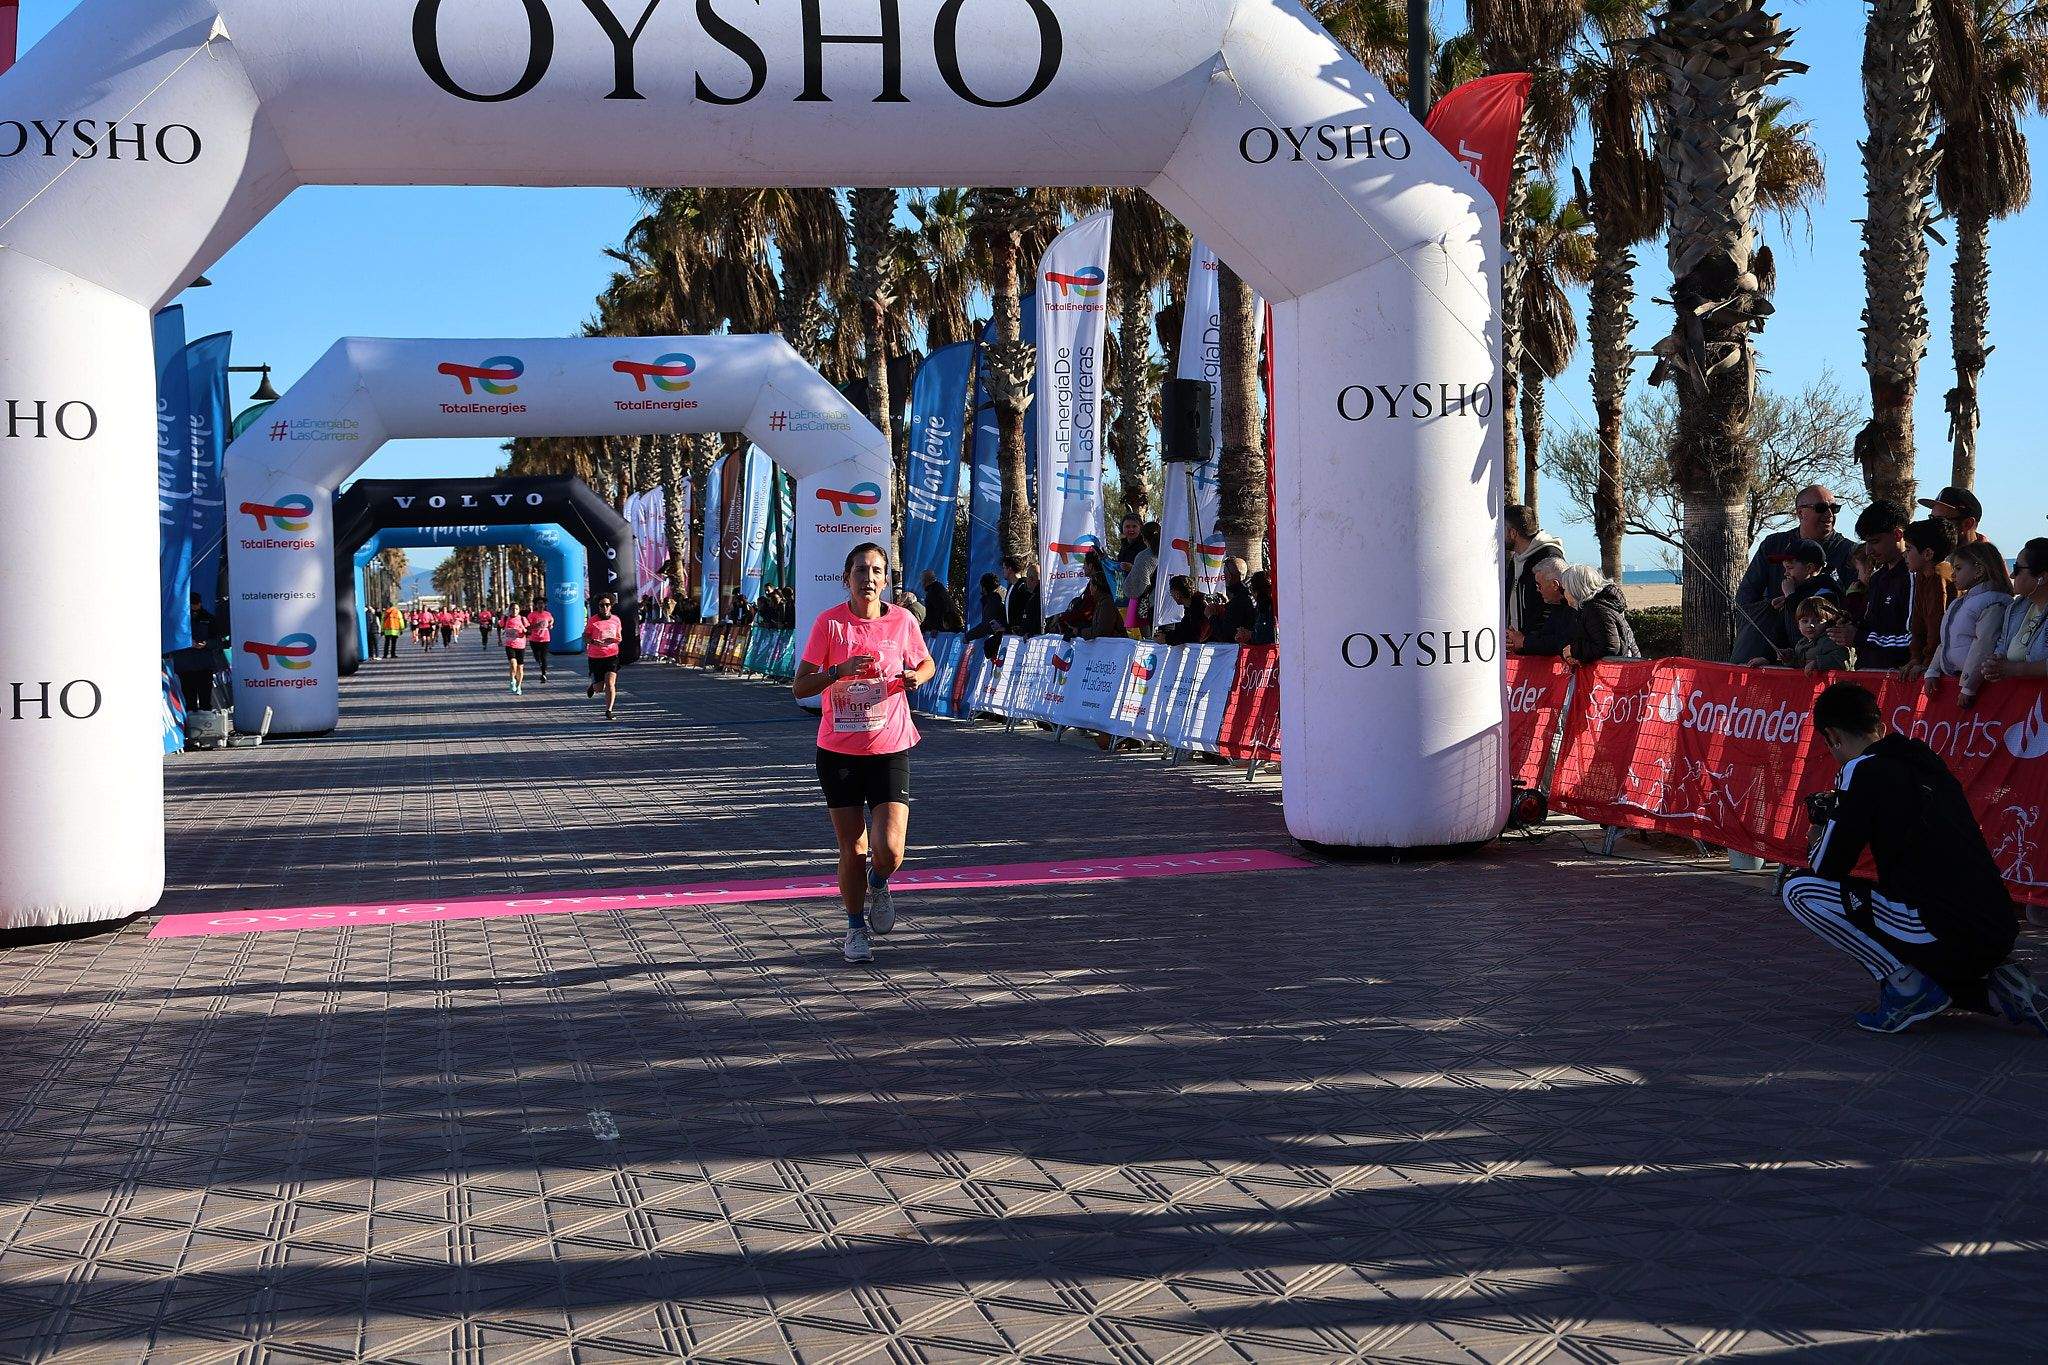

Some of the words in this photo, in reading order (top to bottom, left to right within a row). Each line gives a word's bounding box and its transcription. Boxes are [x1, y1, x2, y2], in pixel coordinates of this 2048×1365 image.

[412, 0, 1063, 107] OYSHO
[0, 119, 202, 165] OYSHO
[1239, 124, 1411, 164] OYSHO
[1046, 303, 1104, 313] TotalEnergies
[439, 403, 527, 415] TotalEnergies
[614, 398, 699, 412] TotalEnergies
[1055, 347, 1072, 464] LaEnergíaDe
[1075, 347, 1094, 463] LasCarreras
[1337, 382, 1493, 422] OYSHO
[5, 399, 98, 441] HO
[788, 421, 851, 431] LasCarreras
[290, 430, 359, 441] LasCarreras
[907, 415, 956, 523] Marlene
[394, 493, 543, 509] VOLVO
[815, 523, 882, 535] TotalEnergies
[240, 539, 315, 550] TotalEnergies
[242, 591, 316, 601] totalenergies.es
[1341, 627, 1496, 669] OYSHO
[243, 677, 318, 688] TotalEnergies
[1242, 663, 1279, 696] Sports
[0, 678, 102, 719] HO
[1586, 681, 1656, 742] Sports
[1682, 690, 1811, 744] Santander
[1049, 856, 1252, 877] OYSHO
[506, 889, 728, 907] OYSHO
[208, 904, 446, 927] OYSHO
